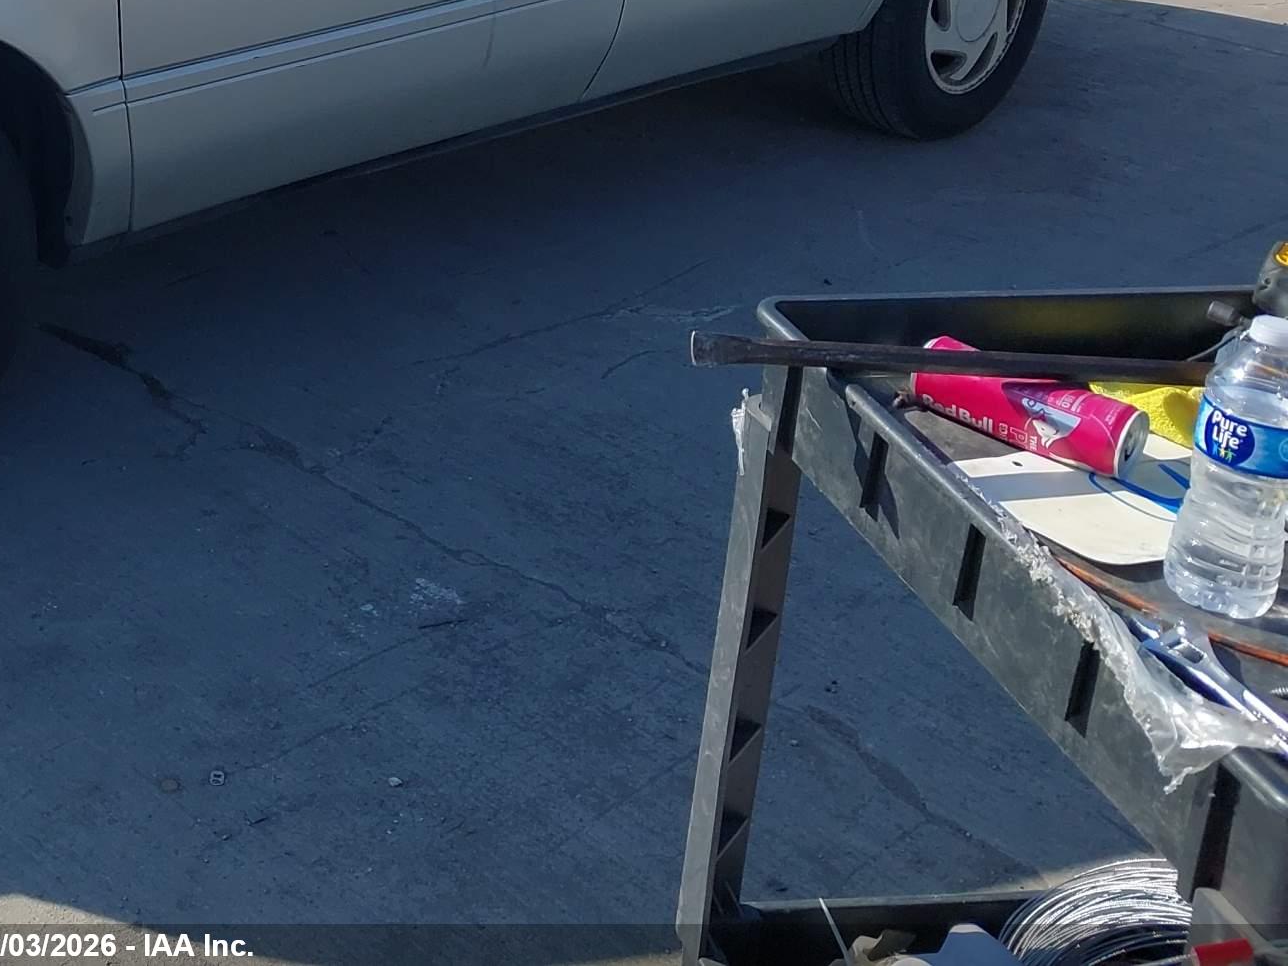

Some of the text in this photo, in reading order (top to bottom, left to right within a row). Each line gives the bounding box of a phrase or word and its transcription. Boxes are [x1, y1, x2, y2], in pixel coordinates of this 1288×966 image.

[958, 407, 994, 433] Bull
[1212, 410, 1248, 437] Pure
[1212, 425, 1240, 450] Life
